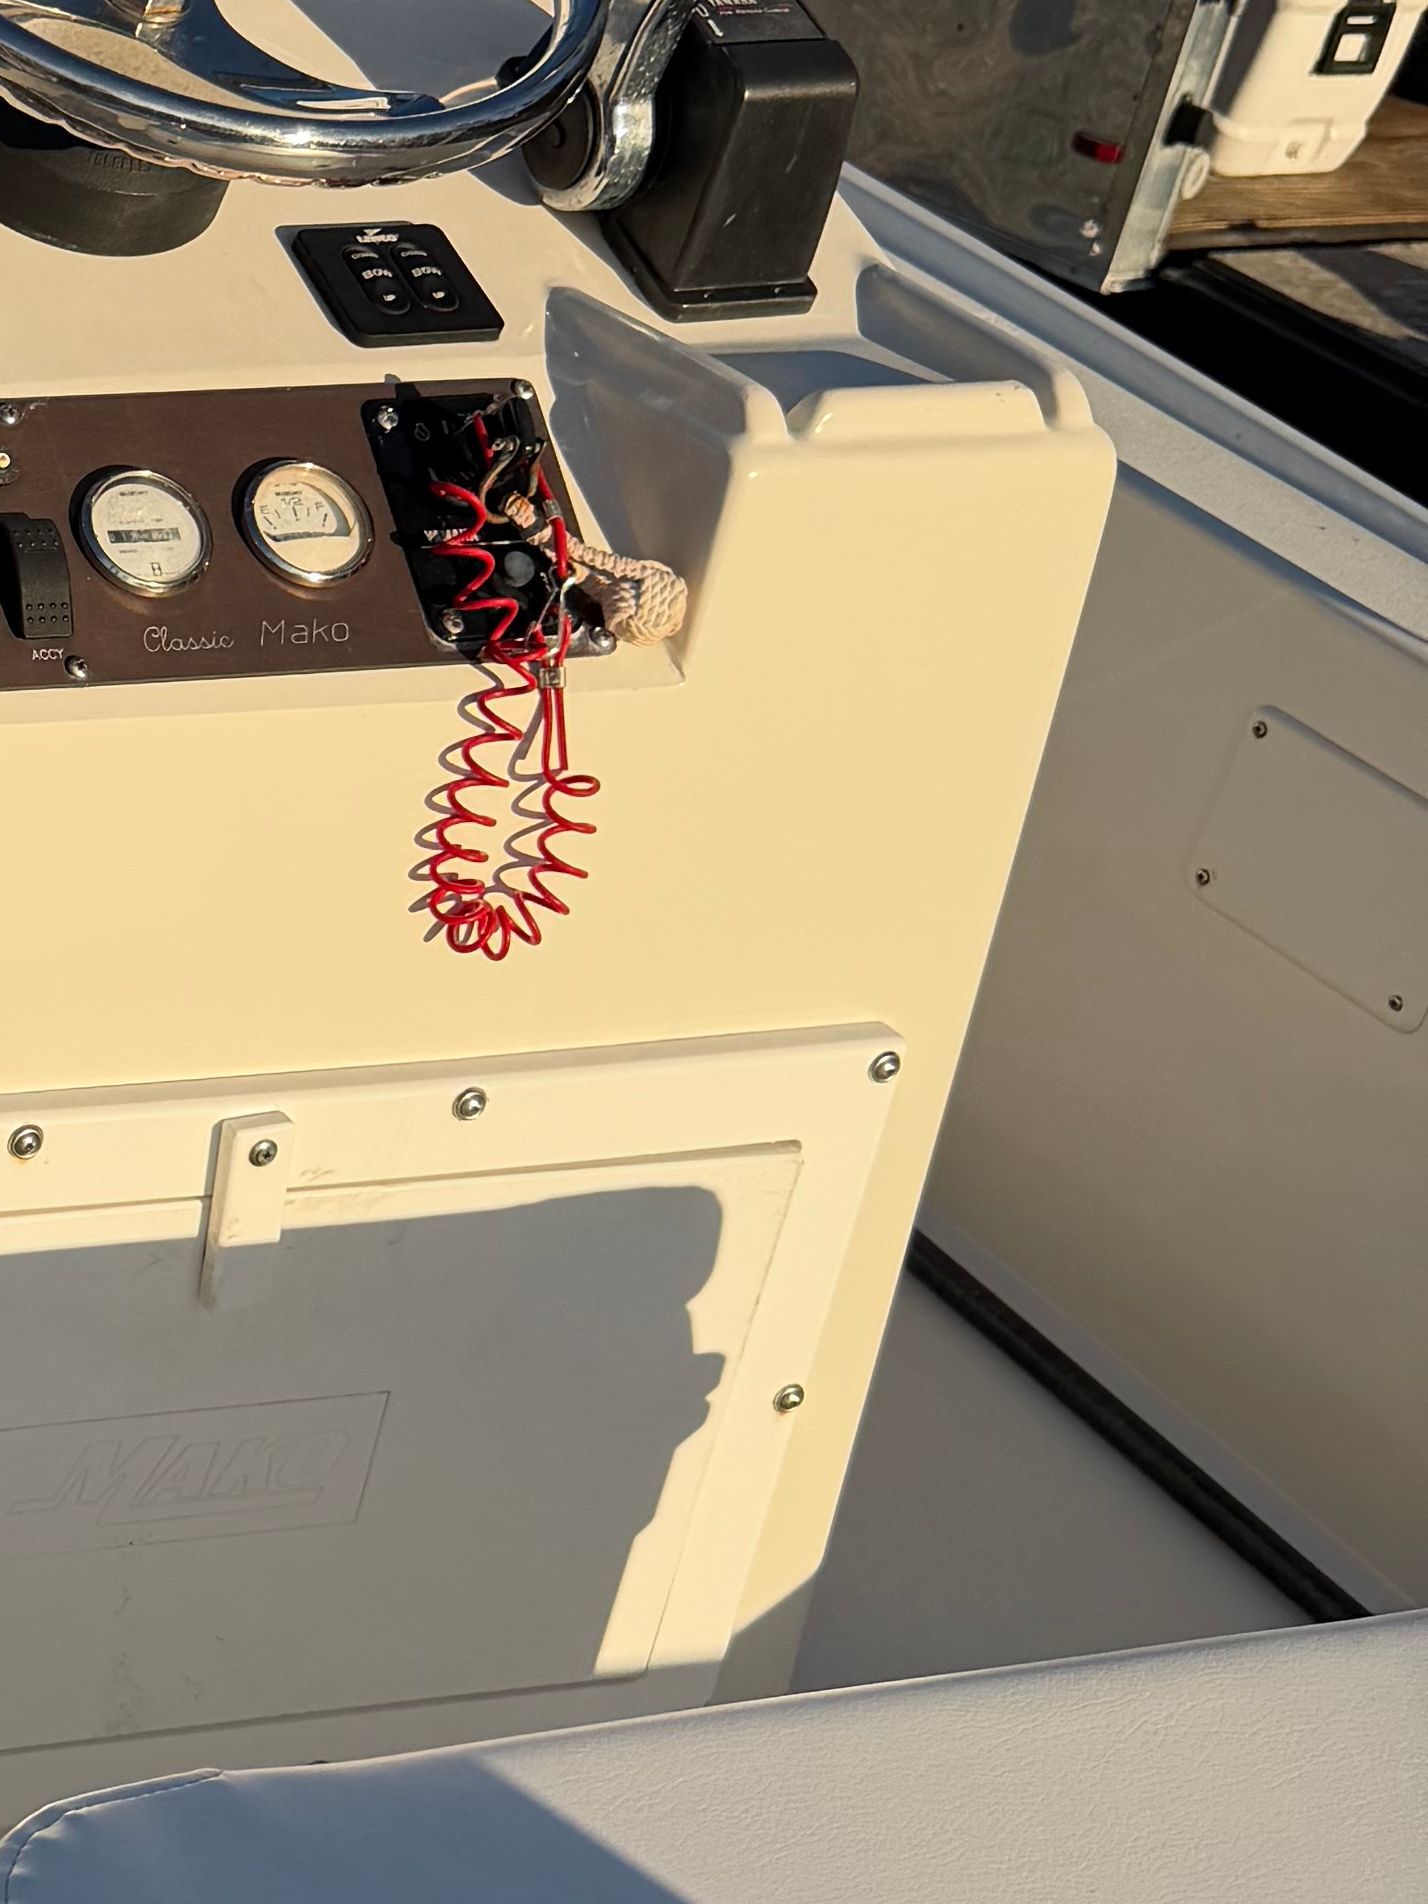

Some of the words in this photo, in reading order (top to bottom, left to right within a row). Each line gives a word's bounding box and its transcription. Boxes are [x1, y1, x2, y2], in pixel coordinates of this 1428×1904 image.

[143, 626, 235, 653] Classic
[260, 618, 350, 646] Mako
[31, 648, 64, 661] ACCY
[6, 1430, 350, 1527] MAKO
